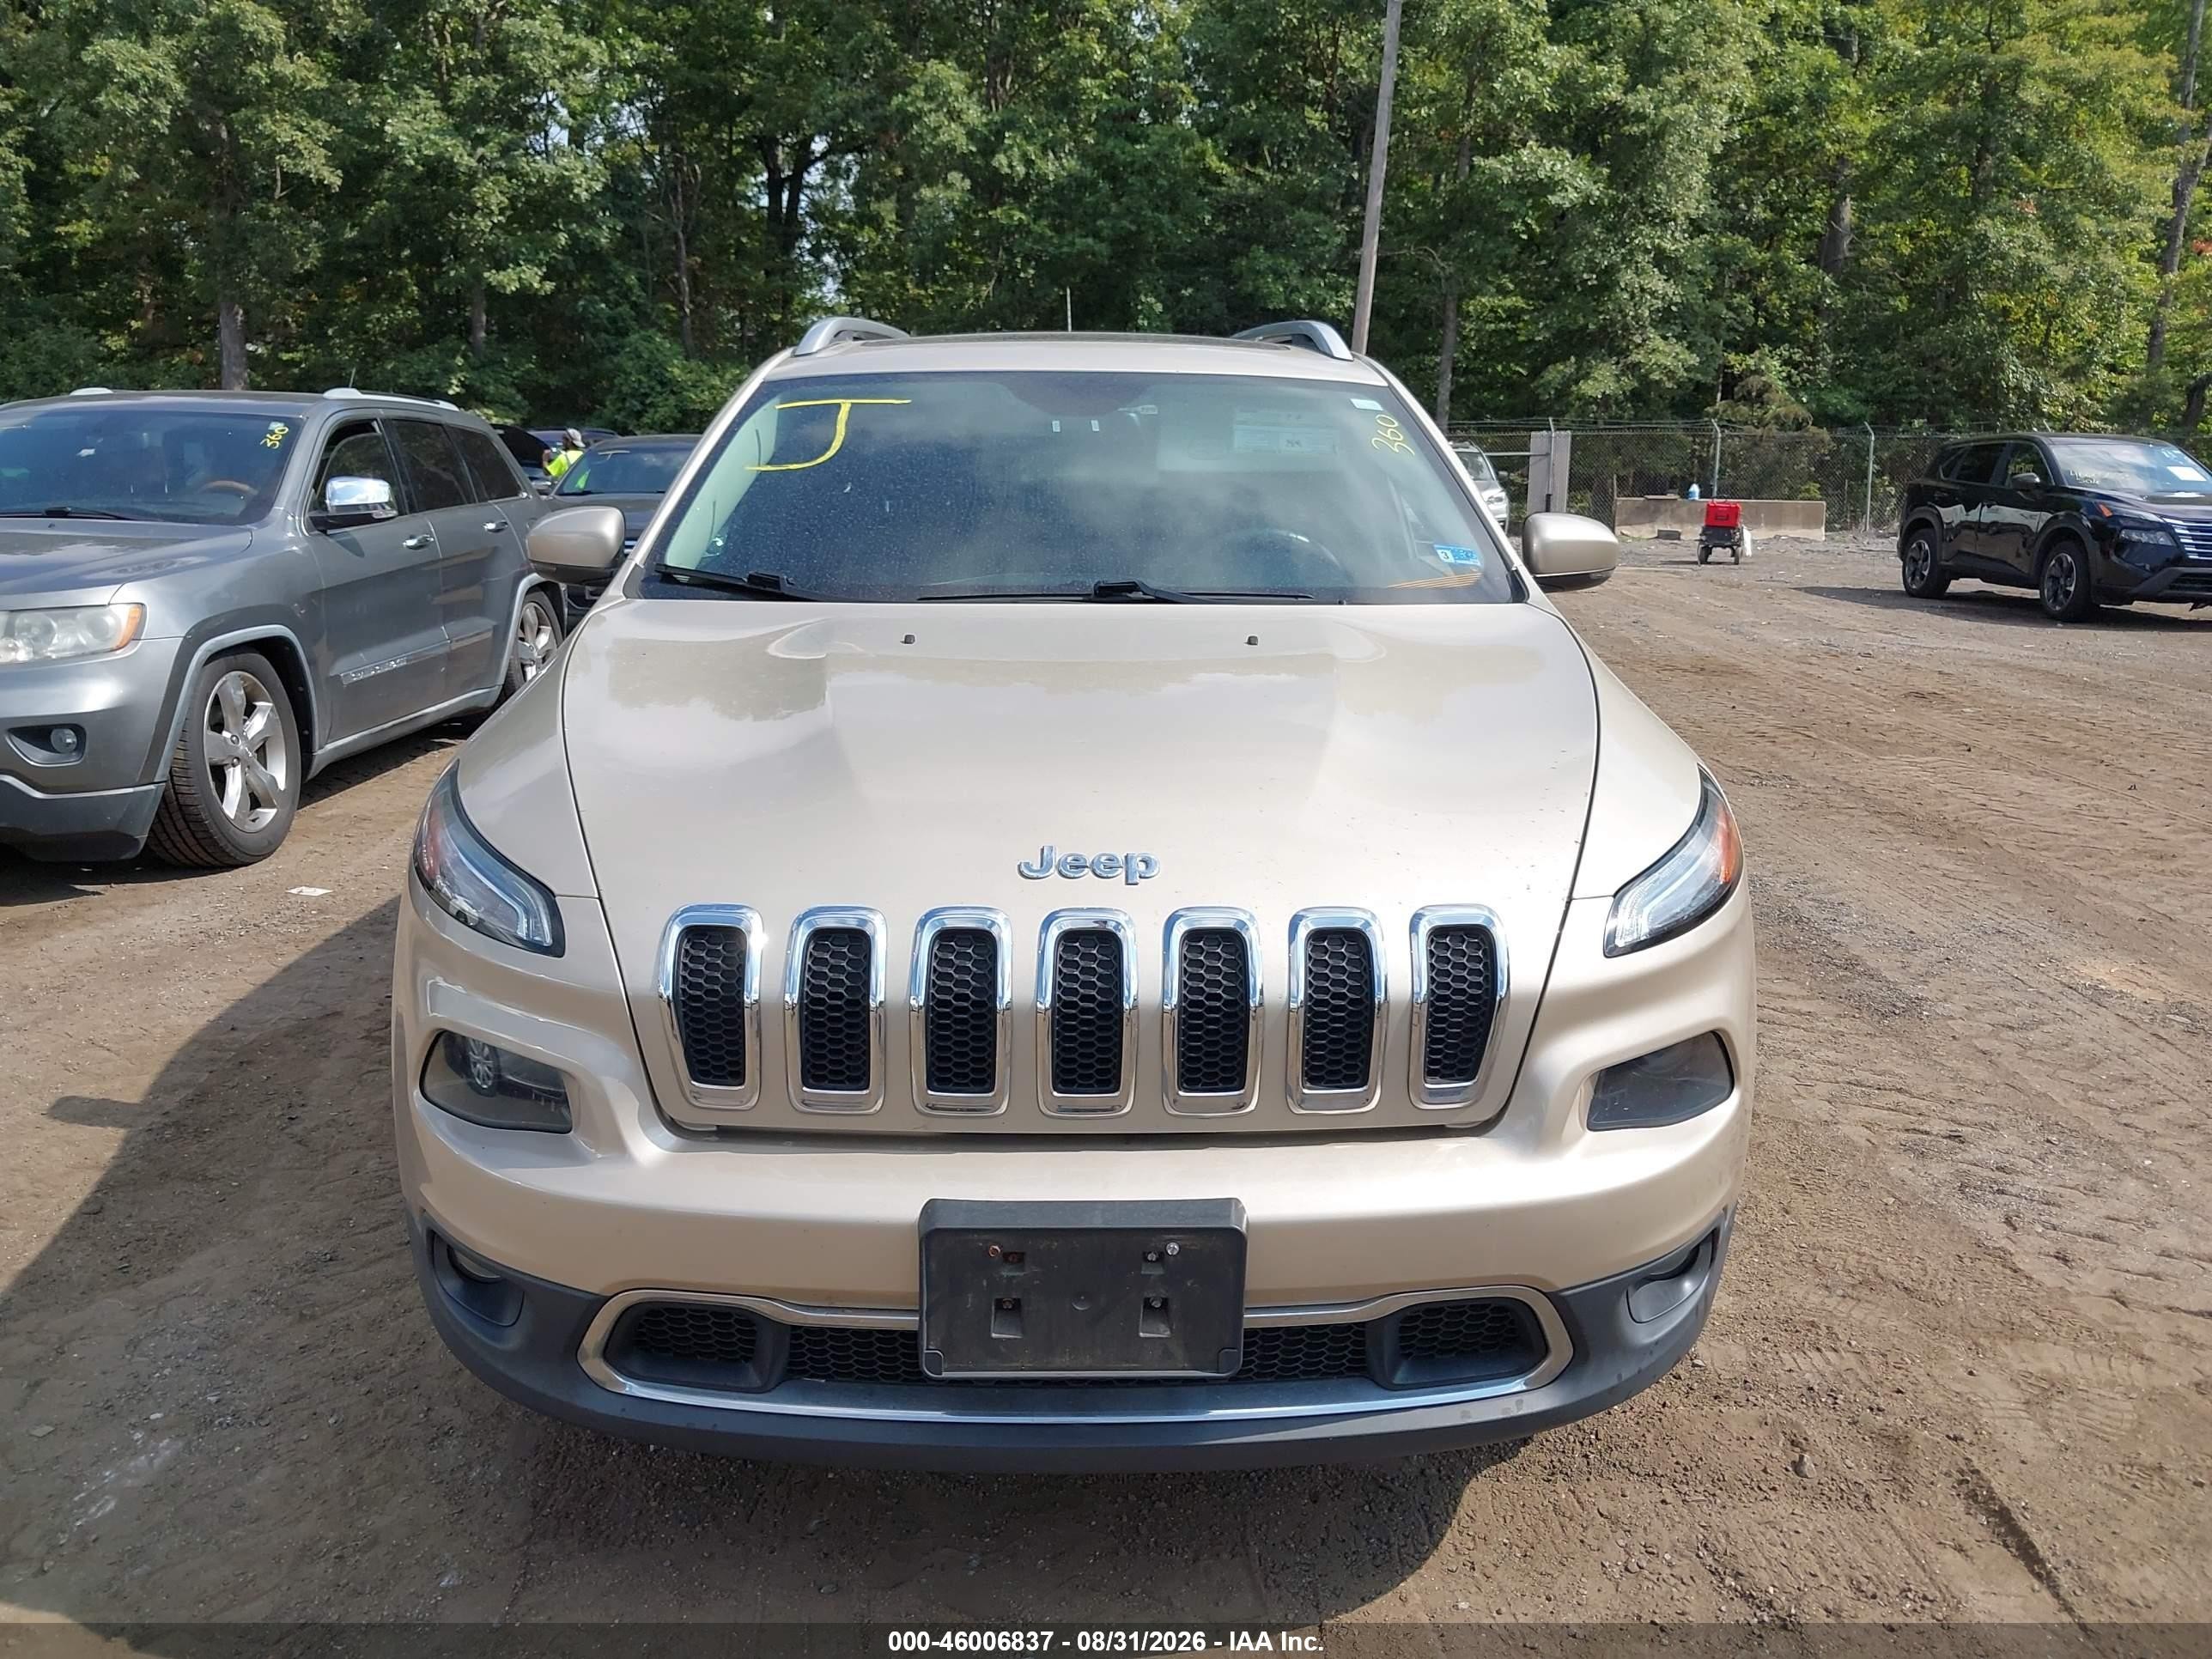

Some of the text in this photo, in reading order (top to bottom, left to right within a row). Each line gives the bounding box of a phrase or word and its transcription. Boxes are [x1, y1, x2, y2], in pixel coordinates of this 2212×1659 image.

[259, 426, 289, 449] 360
[744, 398, 912, 471] J
[1370, 413, 1416, 456] 360
[1441, 550, 1449, 560] 3
[1018, 845, 1160, 885] Jeep
